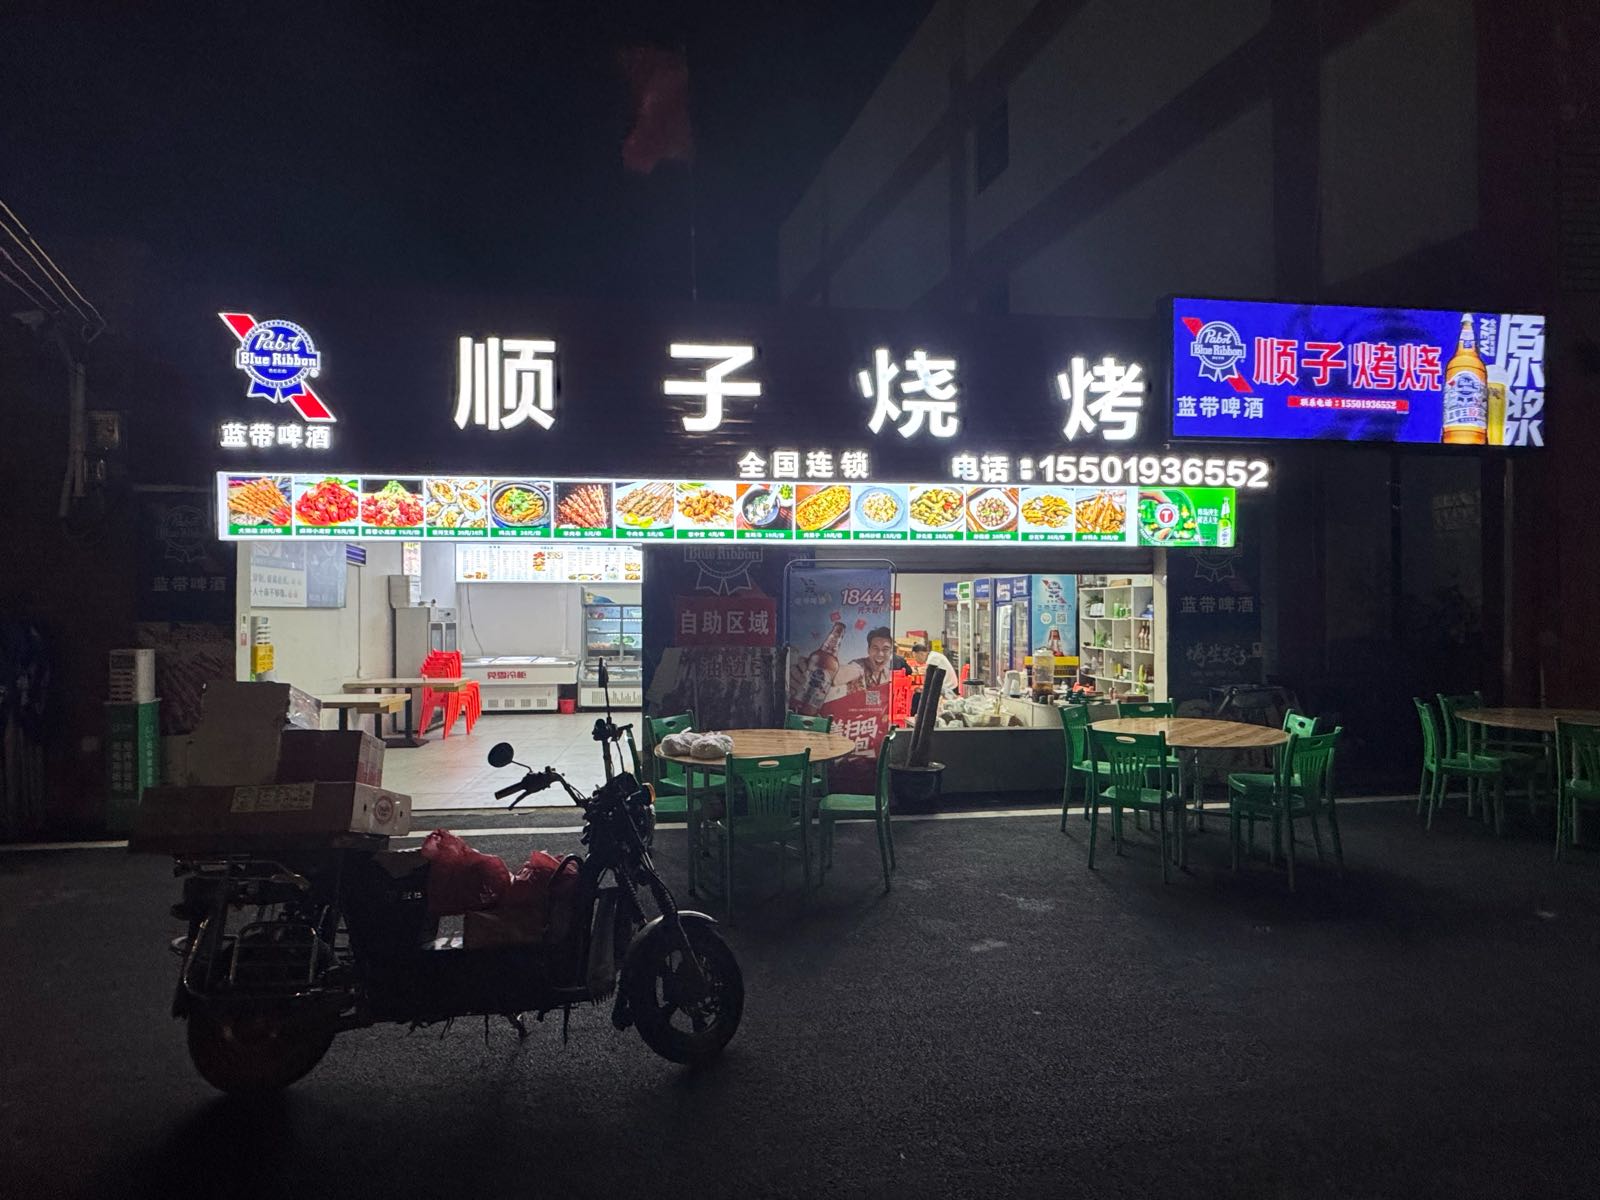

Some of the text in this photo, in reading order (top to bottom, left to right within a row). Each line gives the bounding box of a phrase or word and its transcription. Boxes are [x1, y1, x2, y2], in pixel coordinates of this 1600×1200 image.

[255, 329, 302, 351] Pabst
[1205, 329, 1233, 344] Pabst
[240, 352, 317, 367] Blue Ribbon
[1193, 344, 1243, 356] Blue Ribbon
[1252, 337, 1442, 392] 顺子烤烧
[453, 335, 1148, 442] 顺子烧烤
[1176, 395, 1264, 419] 蓝带啤酒
[219, 423, 332, 449] 蓝带啤酒
[737, 451, 869, 480] 全国连锁
[689, 546, 760, 561] Blue Ribbon
[841, 587, 885, 606] 1844
[1180, 595, 1255, 614] 蓝带啤酒
[680, 609, 769, 636] 自助区域
